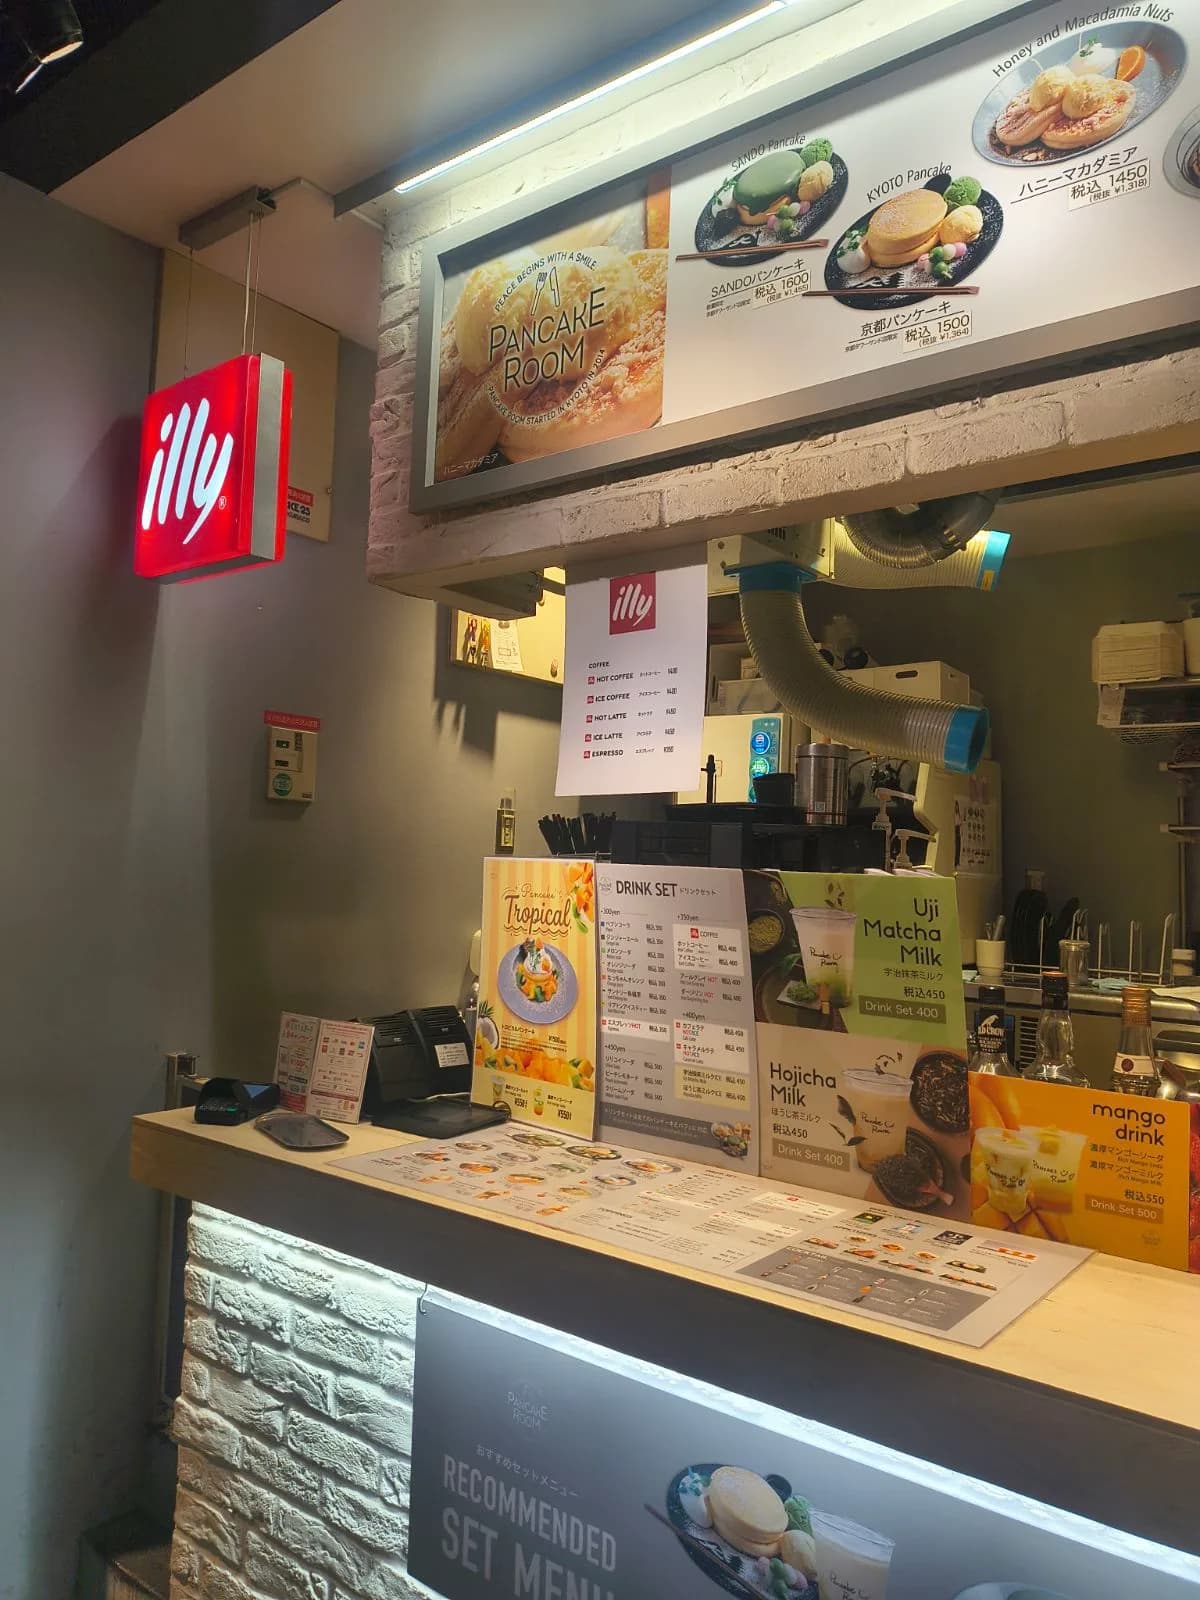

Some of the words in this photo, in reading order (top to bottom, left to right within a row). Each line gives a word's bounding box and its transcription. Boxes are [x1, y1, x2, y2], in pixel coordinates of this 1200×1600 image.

[992, 43, 1033, 78] Honey
[1036, 27, 1060, 47] and
[1064, 3, 1141, 33] Macadamia
[1143, 2, 1174, 23] Nuts
[731, 143, 765, 172] SANDO
[768, 132, 806, 151] Pancake
[866, 175, 904, 204] KYOTO
[906, 162, 952, 191] Pancake
[1019, 146, 1138, 197] ハニーマカダミア
[1070, 180, 1102, 200] 税込
[1109, 164, 1148, 187] 1450
[494, 281, 518, 313] PEACE
[516, 258, 545, 284] BEGINS
[547, 251, 567, 264] WITH
[568, 251, 574, 261] A
[711, 258, 805, 298] SANDOパンケーキ
[755, 284, 776, 300] 税込
[781, 272, 809, 290] 1600
[489, 286, 605, 362] PANCAKE
[860, 300, 952, 337] 京都パンケーキ
[904, 326, 931, 342] 税込
[937, 314, 970, 334] 1500
[504, 335, 584, 393] ROOM
[487, 386, 507, 416] PANCAKE
[526, 410, 556, 425] STARTED
[557, 405, 565, 416] IN
[567, 383, 588, 408] KYOTO
[587, 370, 595, 381] IN
[594, 349, 606, 370] 2014
[141, 397, 234, 545] illy
[612, 583, 654, 628] illy
[588, 661, 610, 669] COFFEE
[610, 672, 634, 681] COFFEE
[607, 693, 631, 701] COFFEE
[608, 712, 627, 721] LATTE
[604, 732, 623, 740] LATTE
[592, 749, 624, 757] ESPRESSO
[616, 880, 652, 897] DRINK
[655, 882, 678, 897] SET
[504, 894, 571, 934] Tropical
[913, 897, 939, 923] Uji
[863, 918, 941, 942] Matcha
[900, 945, 943, 967] Milk
[882, 967, 944, 982] 宇治抹茶ミルク
[903, 986, 946, 1000] 税込450
[865, 1000, 892, 1014] Drink
[896, 1004, 913, 1017] Set
[917, 1006, 939, 1019] 400
[769, 1062, 838, 1089] Hojicha
[770, 1084, 807, 1107] Milk
[771, 1107, 822, 1124] ほうじ茶ミルク
[1092, 1103, 1166, 1128] mango
[773, 1122, 808, 1139] 税込450
[1115, 1124, 1165, 1147] drink
[778, 1142, 802, 1158] Drink
[805, 1149, 821, 1162] Set
[824, 1153, 844, 1167] 400
[1091, 1199, 1115, 1212] Drink
[1118, 1203, 1134, 1216] Set
[1136, 1207, 1157, 1220] 500
[1124, 1188, 1165, 1205] 税込550
[475, 1444, 580, 1497] おすすめセットメニュー
[443, 1454, 617, 1573] RECOMMENDED
[441, 1506, 499, 1582] SET
[512, 1541, 615, 1600] MEN
